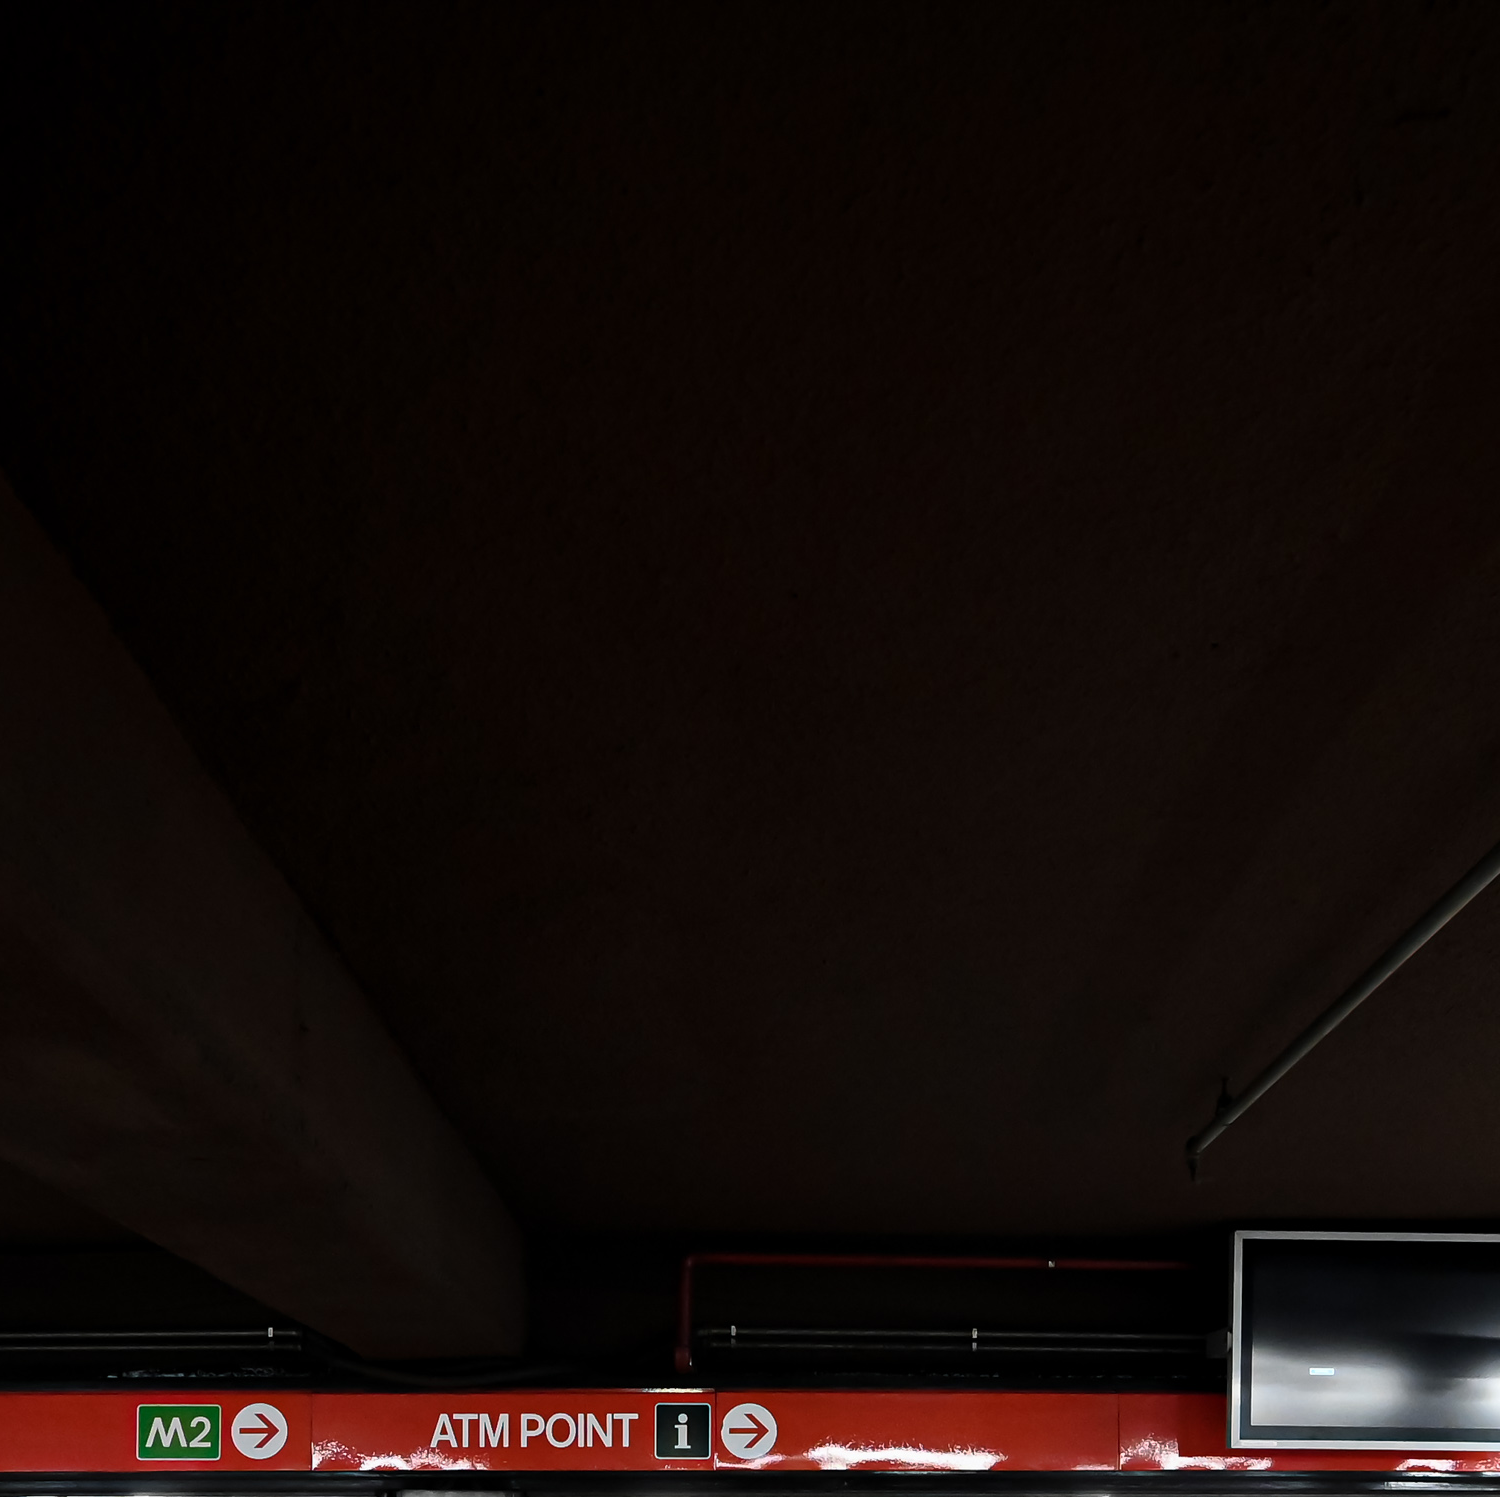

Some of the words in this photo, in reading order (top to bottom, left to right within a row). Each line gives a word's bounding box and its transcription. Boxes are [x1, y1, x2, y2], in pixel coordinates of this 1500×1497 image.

[145, 1416, 212, 1448] M2
[430, 1413, 510, 1448] ATM
[520, 1412, 639, 1449] POINT
